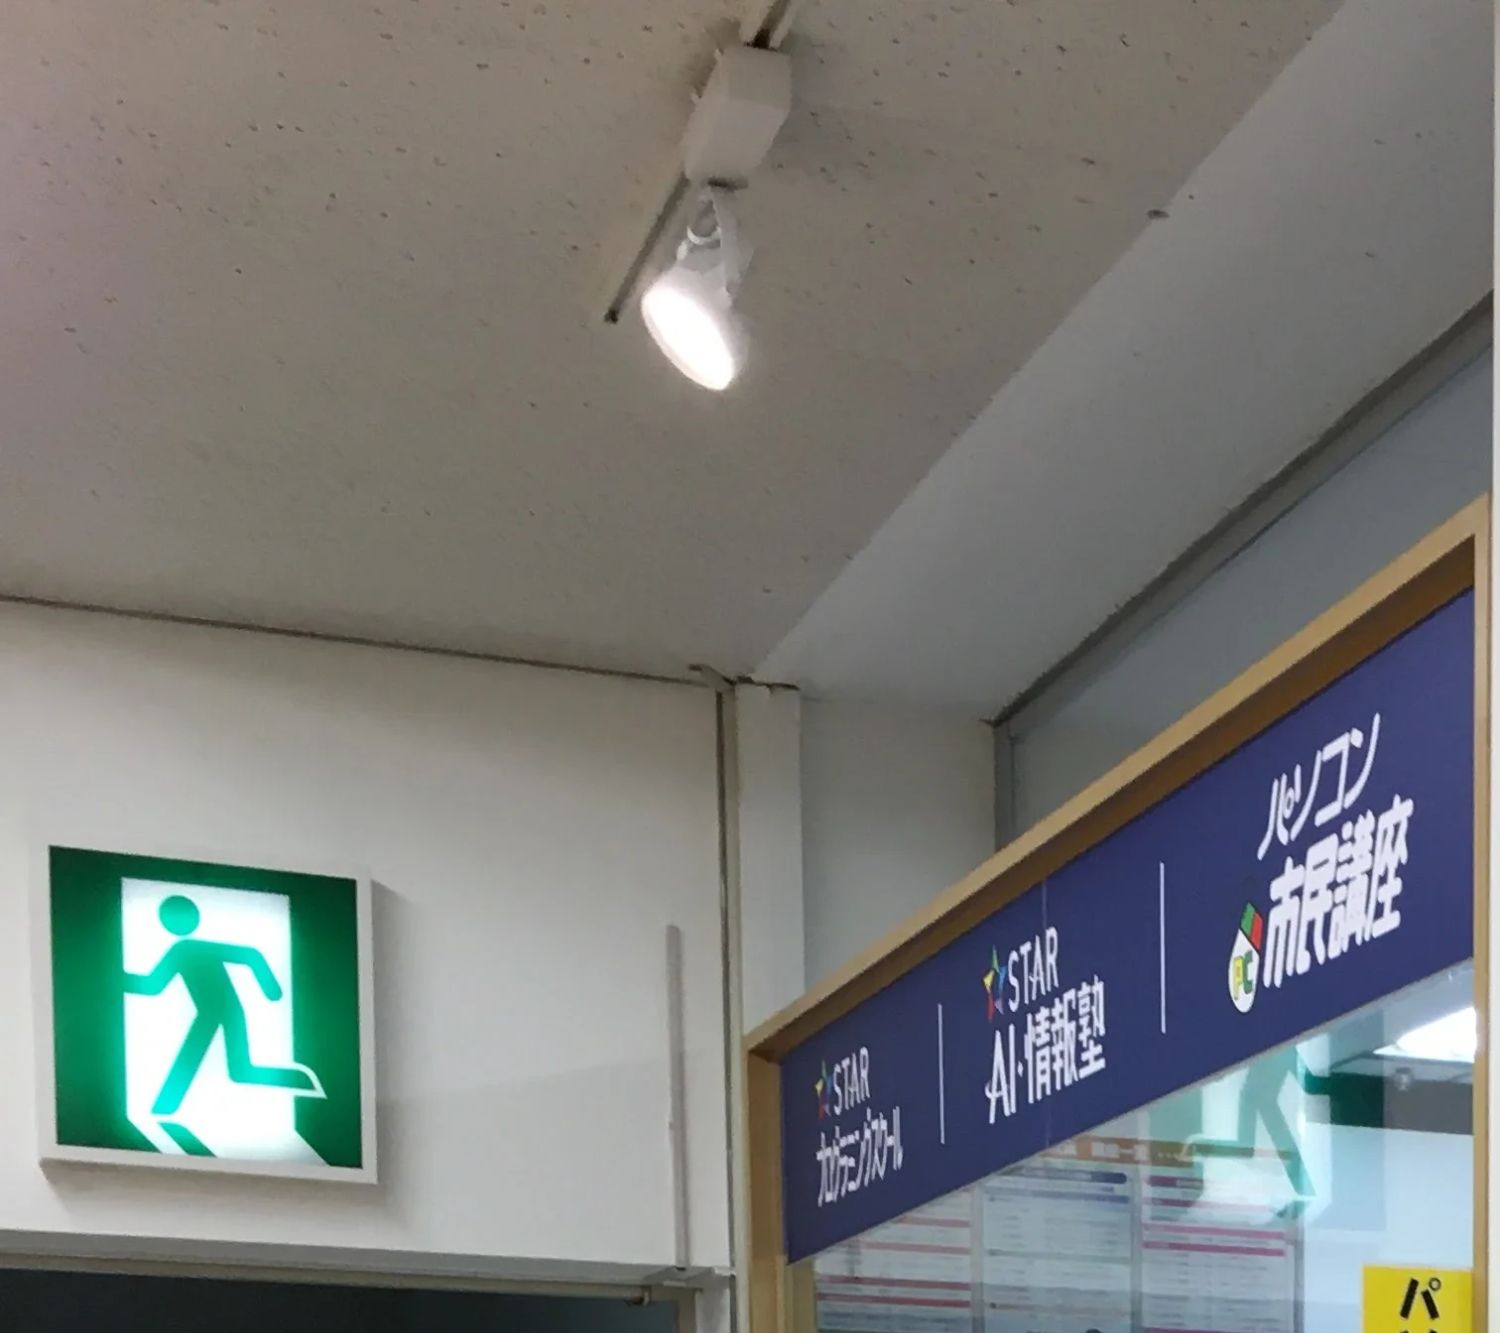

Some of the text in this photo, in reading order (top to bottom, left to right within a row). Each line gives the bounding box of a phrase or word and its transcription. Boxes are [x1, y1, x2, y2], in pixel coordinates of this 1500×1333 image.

[1258, 712, 1382, 860] パソコン
[1263, 795, 1415, 990] 市民講座
[1008, 926, 1060, 1013] STAR
[833, 1046, 870, 1116] STAR
